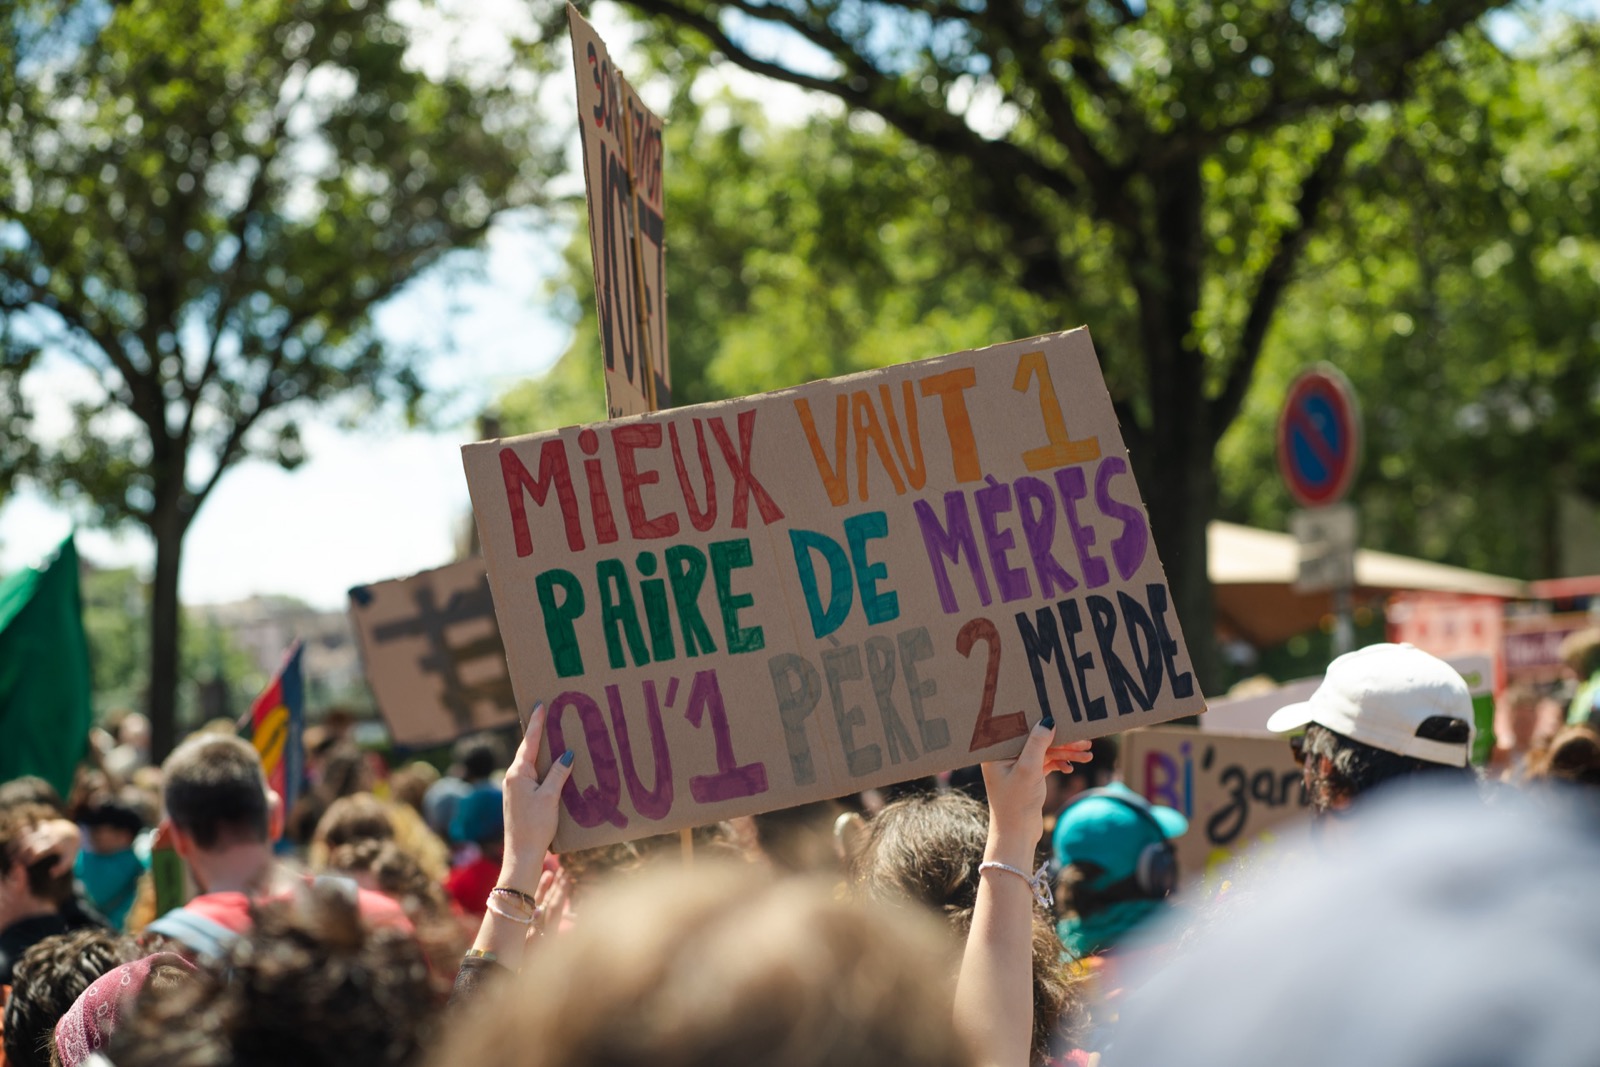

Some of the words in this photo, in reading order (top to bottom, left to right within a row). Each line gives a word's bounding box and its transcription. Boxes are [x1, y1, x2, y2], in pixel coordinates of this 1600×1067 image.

[794, 367, 982, 506] VAUT
[1012, 351, 1100, 472] 1
[788, 510, 900, 639] DE
[913, 456, 1149, 614] MÈRES
[545, 669, 769, 829] QU'1
[768, 626, 952, 786] PÈRE
[956, 617, 1029, 752] 2
[1014, 583, 1194, 724] MERDE
